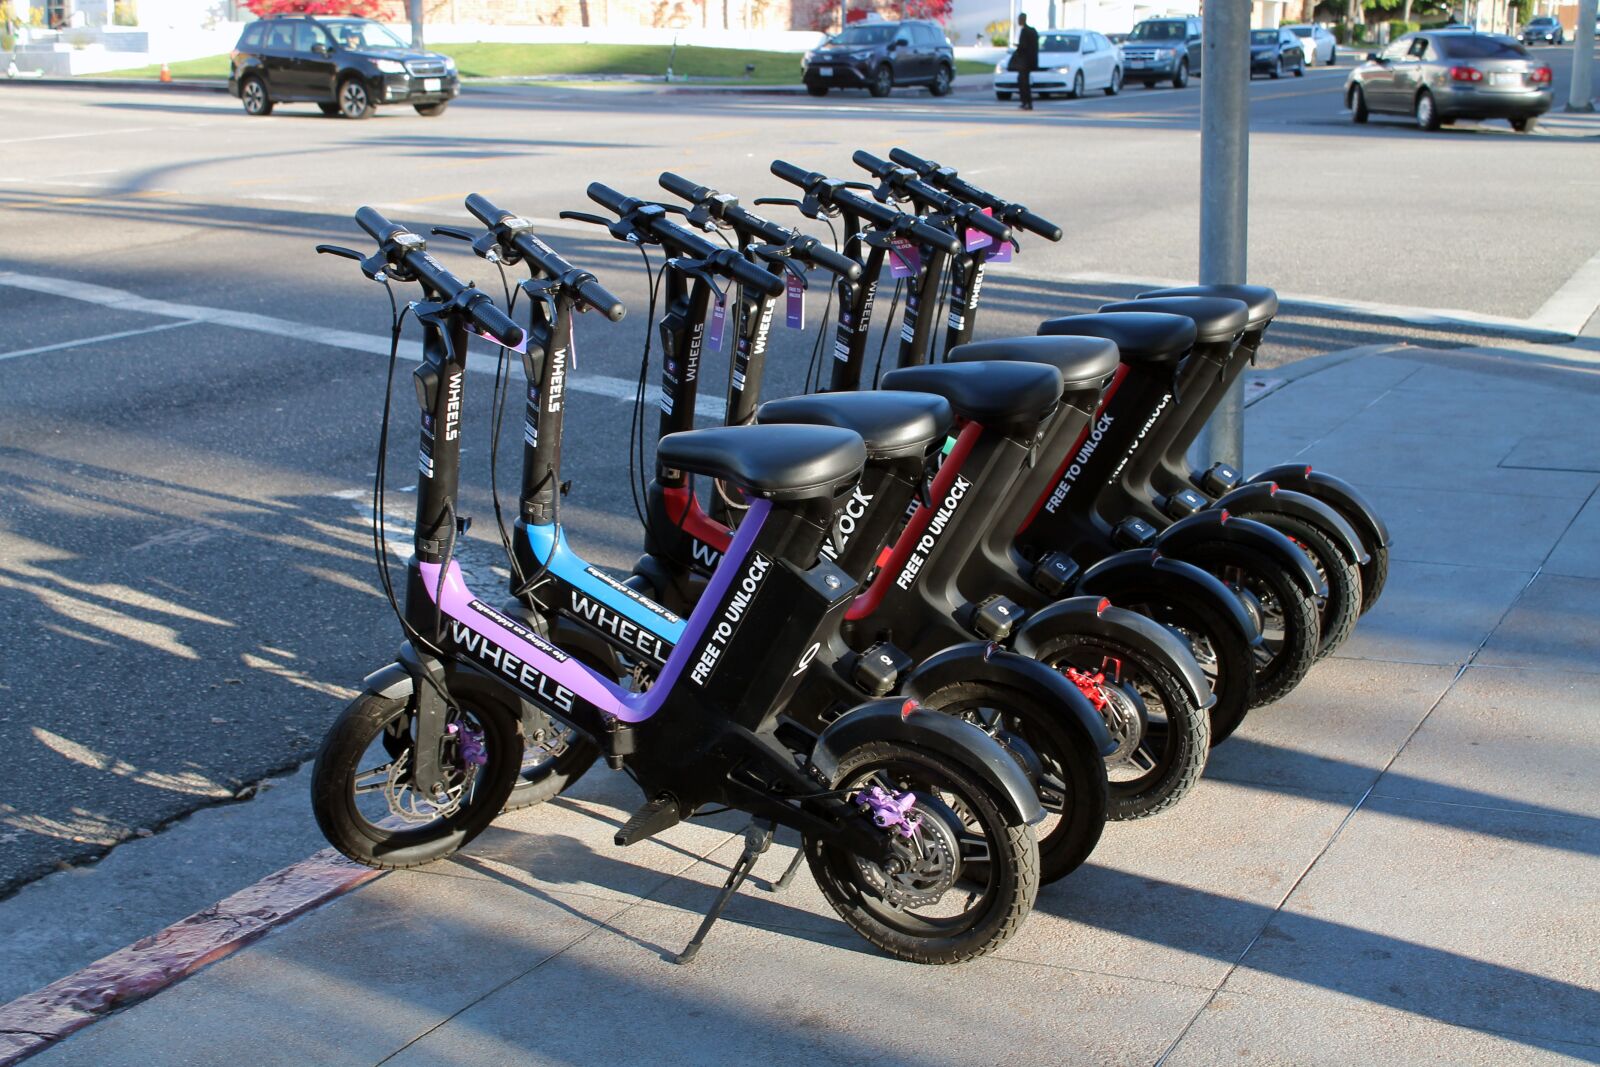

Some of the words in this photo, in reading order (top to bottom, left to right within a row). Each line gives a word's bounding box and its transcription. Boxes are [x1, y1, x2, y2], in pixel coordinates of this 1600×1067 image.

[859, 280, 879, 332] WHEELS
[969, 263, 986, 310] WHEELS
[685, 322, 704, 382] WHEELS
[754, 298, 776, 355] WHEELS
[445, 372, 463, 441] WHEELS
[548, 348, 566, 413] WHEELS
[1045, 483, 1071, 514] FREE
[1067, 464, 1081, 483] TO
[1076, 412, 1114, 465] UNLOCK
[896, 552, 924, 591] FREE
[917, 533, 936, 555] TO
[930, 476, 970, 536] UNLOCK
[472, 600, 514, 629] sidewalks
[638, 597, 665, 614] riding
[664, 612, 678, 623] No
[690, 643, 721, 686] FREE
[712, 621, 733, 646] TO
[725, 554, 770, 627] UNLOCK
[452, 621, 575, 713] WHEELS
[525, 633, 553, 651] riding
[552, 649, 567, 661] No
